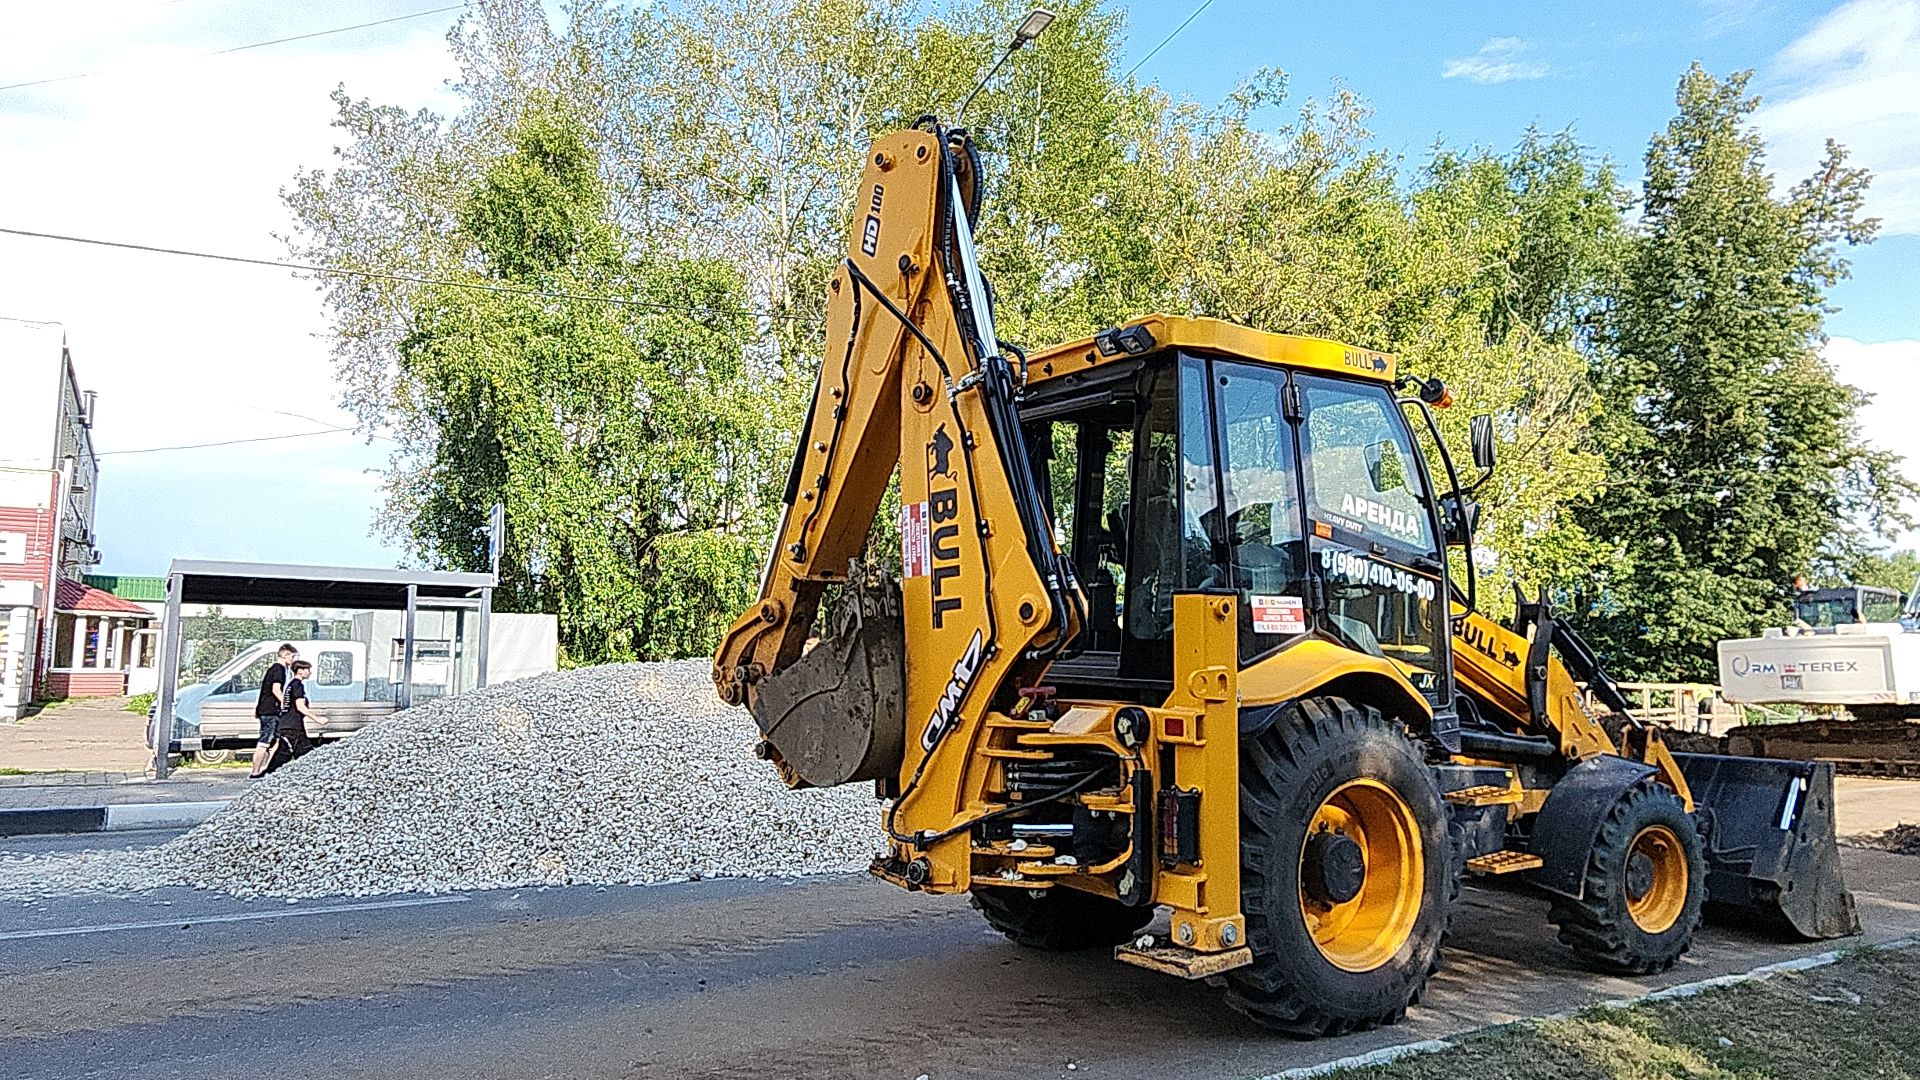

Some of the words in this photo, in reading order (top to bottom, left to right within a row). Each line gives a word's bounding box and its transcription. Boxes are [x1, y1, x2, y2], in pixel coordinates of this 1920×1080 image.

[870, 183, 885, 214] 100
[862, 219, 879, 253] HD
[1343, 350, 1373, 370] BULL
[1323, 512, 1345, 526] HEAVY
[1345, 519, 1364, 533] DUTY
[1340, 492, 1420, 539] АРЕНДА
[930, 488, 962, 630] BULL
[1452, 618, 1498, 659] BULL
[1418, 673, 1437, 690] JX
[1799, 661, 1859, 673] TEREX
[920, 628, 982, 752] 4WD
